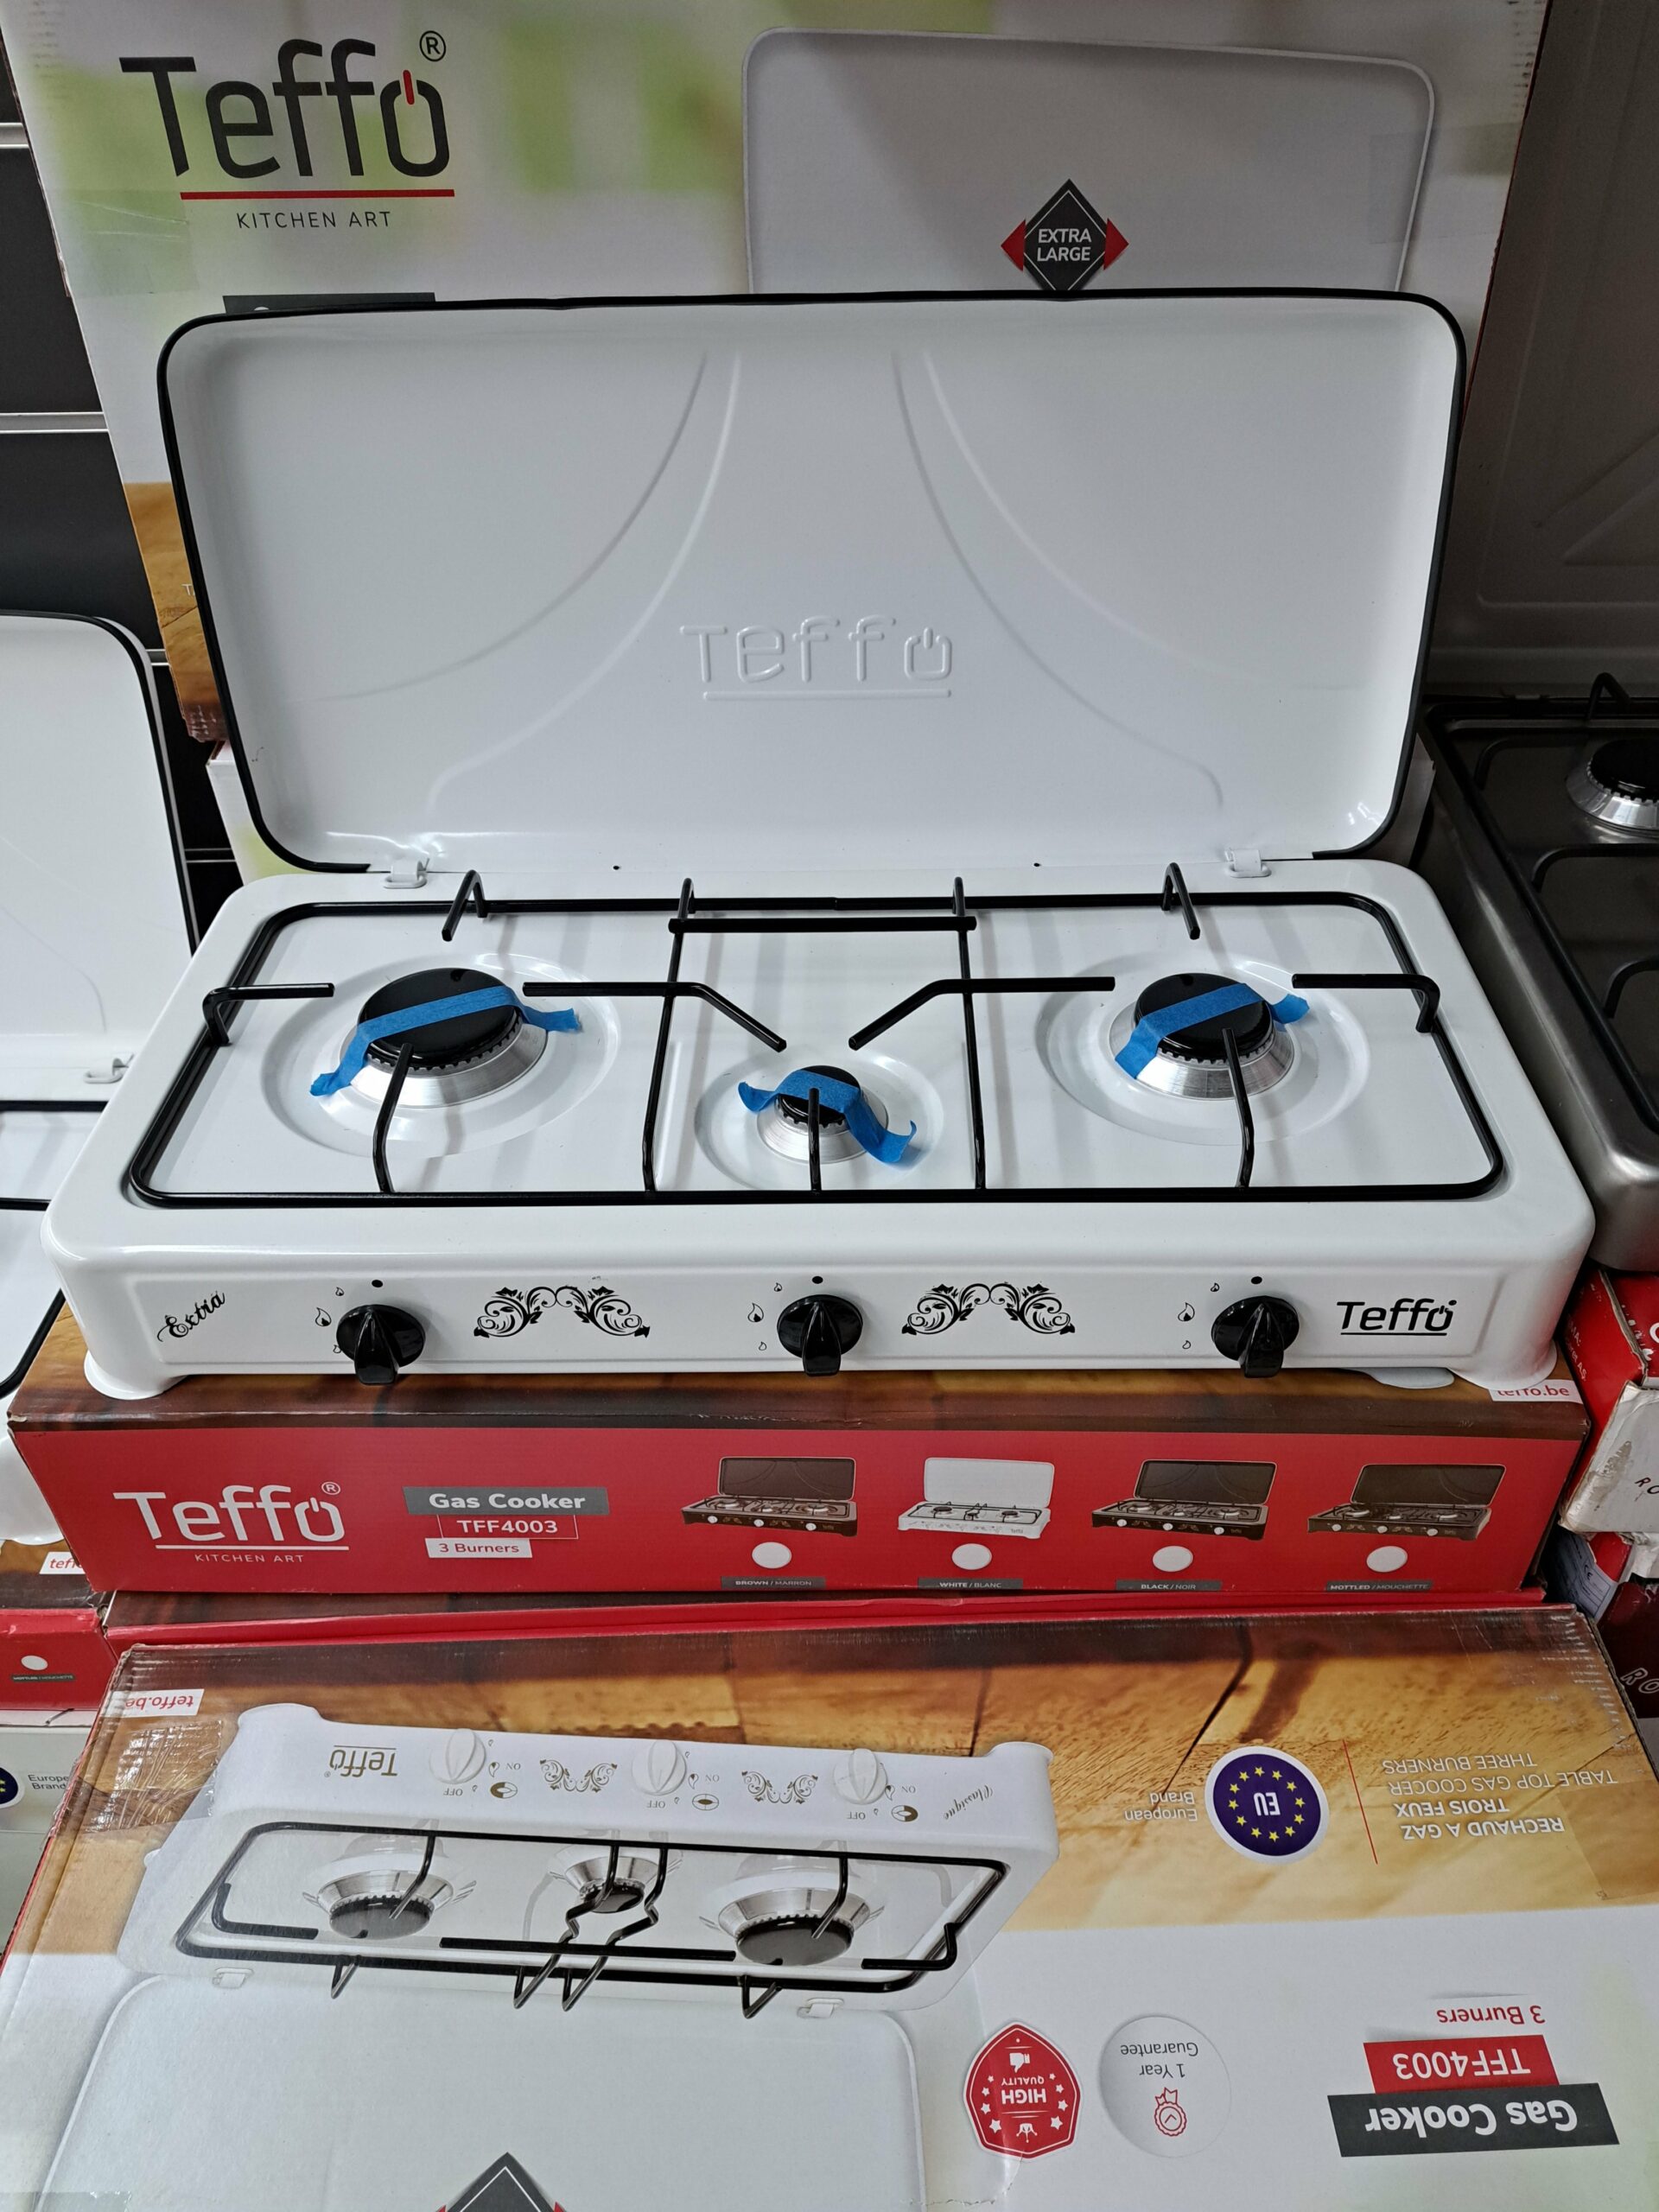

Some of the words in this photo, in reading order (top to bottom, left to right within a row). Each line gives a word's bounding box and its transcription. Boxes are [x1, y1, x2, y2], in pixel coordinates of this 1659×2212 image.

[119, 38, 450, 179] Teffo
[236, 212, 336, 229] KITCHEN
[348, 211, 392, 228] ART
[1038, 228, 1092, 244] EXTRA
[1037, 246, 1092, 262] LARGE
[679, 614, 952, 683] Teffo
[156, 1290, 226, 1343] Extra
[429, 1493, 481, 1510] Gas
[488, 1492, 586, 1510] Cooker
[113, 1484, 345, 1543] Teffo
[456, 1519, 558, 1535] TFF4003
[439, 1542, 449, 1554] 3
[454, 1542, 519, 1554] Burners
[194, 1554, 265, 1564] KITCHEN
[273, 1554, 304, 1563] ART
[125, 1695, 194, 1710] teffo.be
[505, 1762, 522, 1770] ON
[1382, 1755, 1471, 1775] BURNERS
[1477, 1752, 1538, 1770] THREE
[705, 1774, 721, 1783] ON
[1388, 1778, 1467, 1796] COOCER
[1471, 1776, 1511, 1792] GAS
[1516, 1772, 1556, 1789] TOP
[1556, 1770, 1618, 1787] TABLE
[442, 1788, 463, 1796] OFF
[900, 1785, 917, 1794] ON
[1149, 1791, 1196, 1805] Brand
[1253, 1791, 1281, 1816] EU
[1393, 1802, 1446, 1818] FEUX
[1448, 1797, 1510, 1815] TROIS
[846, 1811, 867, 1821] OFF
[1123, 1808, 1198, 1821] European
[1401, 1823, 1442, 1840] GAZ
[1446, 1822, 1461, 1838] A
[1467, 1817, 1566, 1837] RECHAUD
[1436, 2006, 1525, 2025] Burners
[1529, 2005, 1546, 2024] 3
[1120, 2042, 1199, 2057] Guarantee
[1139, 2063, 1174, 2079] Year
[1176, 2063, 1186, 2079] 1
[1392, 2048, 1531, 2080] TFF4003
[1001, 2075, 1045, 2086] QUALITY
[1001, 2088, 1047, 2105] HIGH
[1364, 2103, 1497, 2139] Cooker
[1505, 2100, 1578, 2133] Gas
